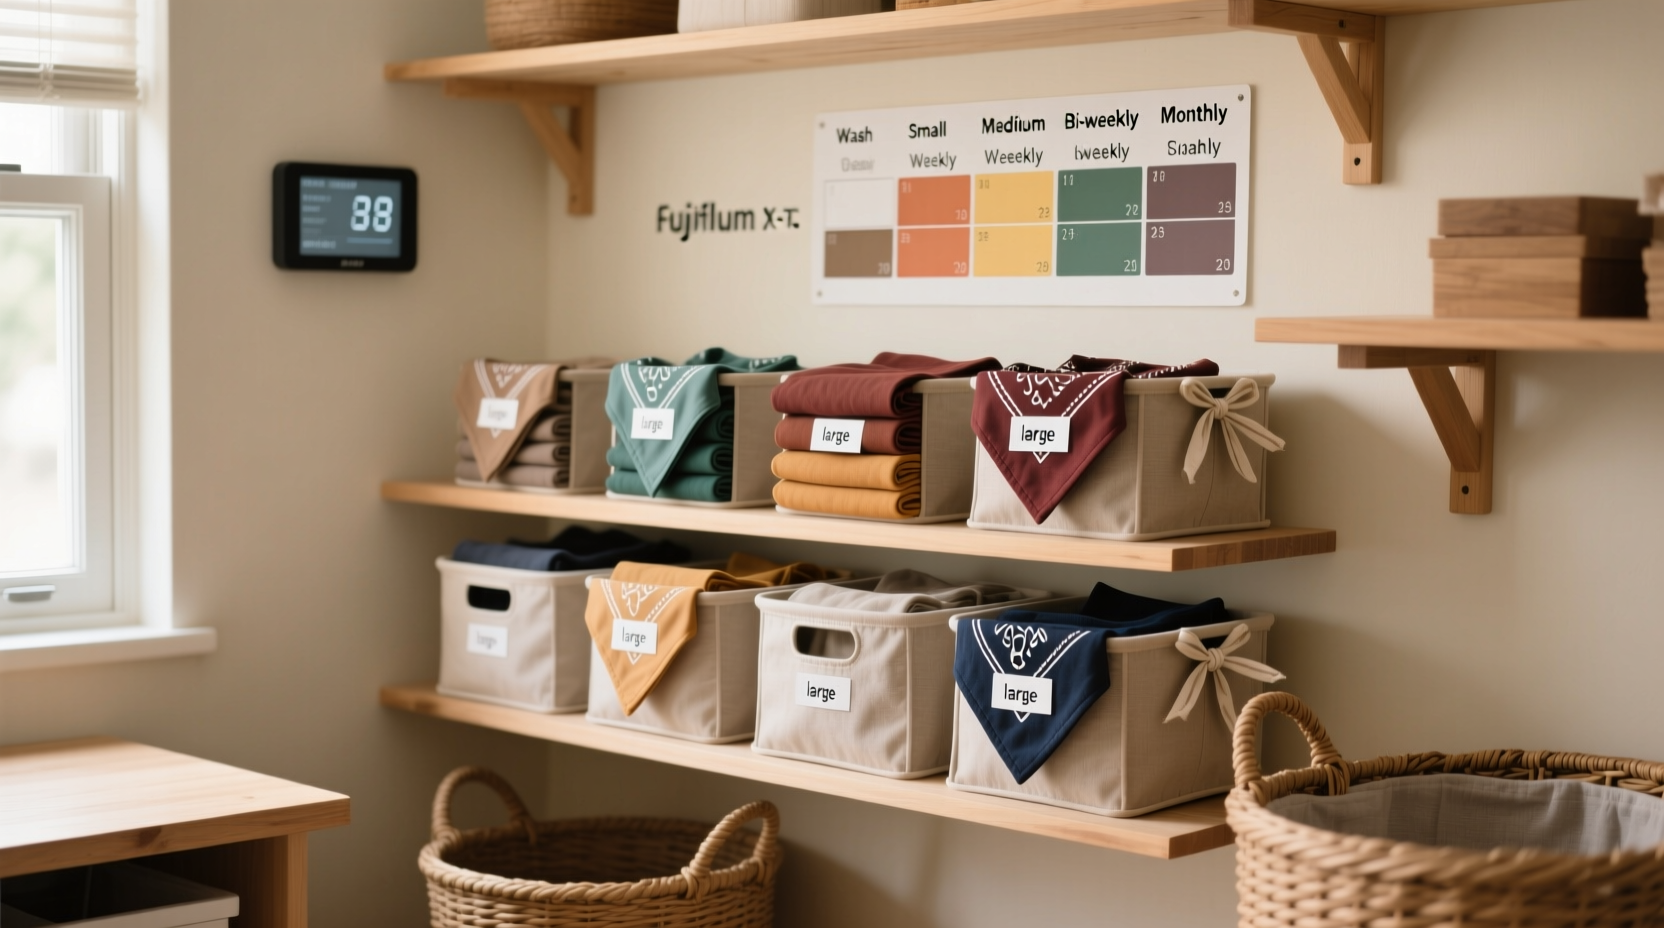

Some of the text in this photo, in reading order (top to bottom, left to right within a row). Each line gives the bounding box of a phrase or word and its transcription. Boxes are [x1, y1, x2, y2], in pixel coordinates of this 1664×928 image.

[836, 126, 873, 144] Wash
[908, 120, 947, 139] Small
[1064, 109, 1139, 131] Bi-weekly
[1161, 103, 1228, 125] Monthly
[909, 151, 957, 171] Weekly
[984, 147, 1043, 168] Weeekly
[1215, 258, 1231, 271] 20
[641, 416, 664, 433] large
[1021, 424, 1056, 445] large
[822, 426, 850, 445] large
[622, 626, 647, 647] large
[806, 681, 836, 703] large
[1004, 683, 1038, 705] large
